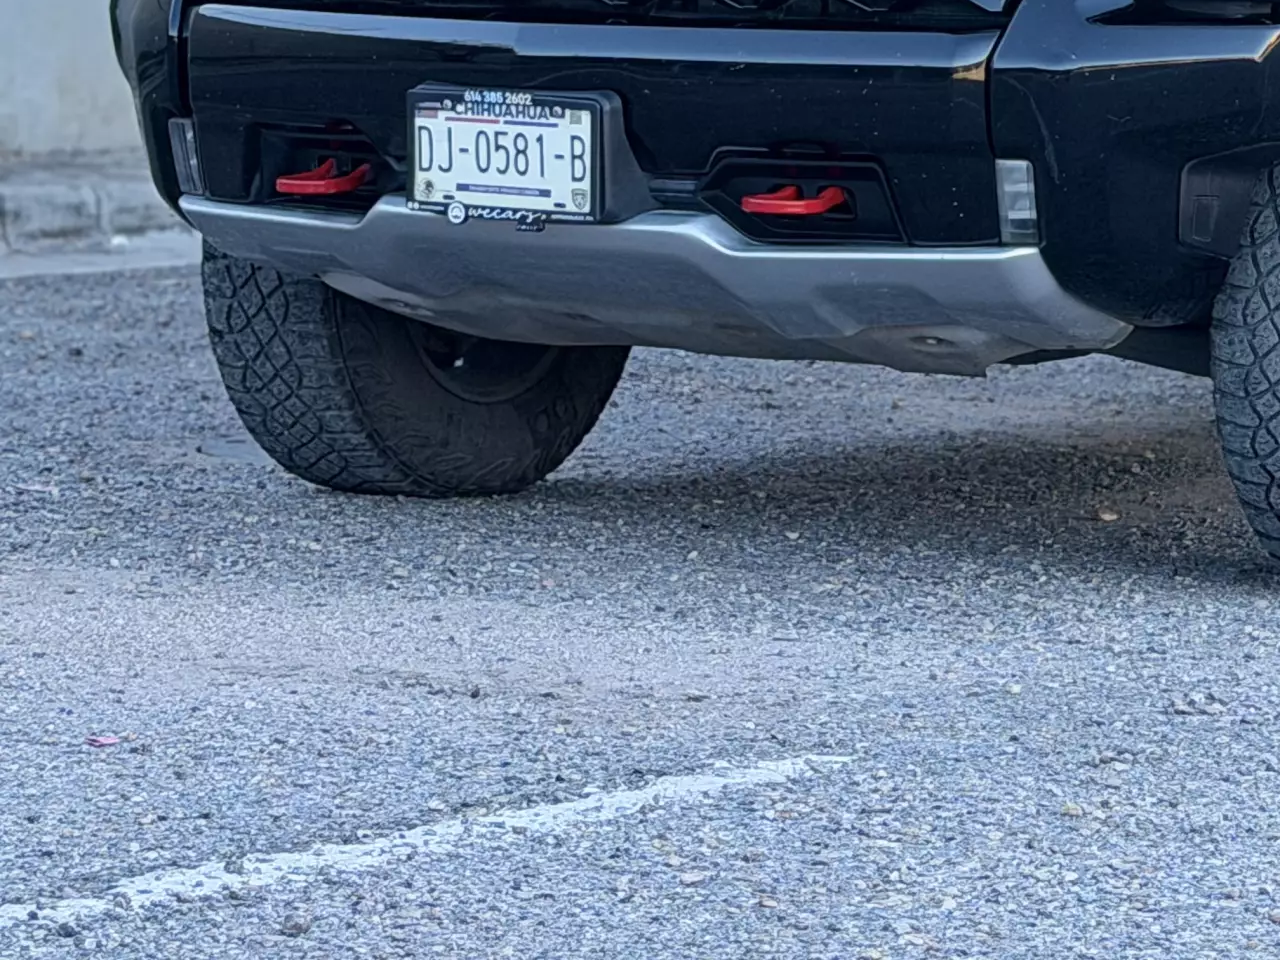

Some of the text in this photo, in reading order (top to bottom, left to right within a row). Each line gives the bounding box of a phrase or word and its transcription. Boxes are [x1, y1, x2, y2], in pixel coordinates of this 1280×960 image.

[464, 89, 482, 102] 614
[505, 91, 532, 106] 2602
[454, 102, 551, 121] CHIHUAHUA
[417, 125, 587, 183] DJ-0581-B
